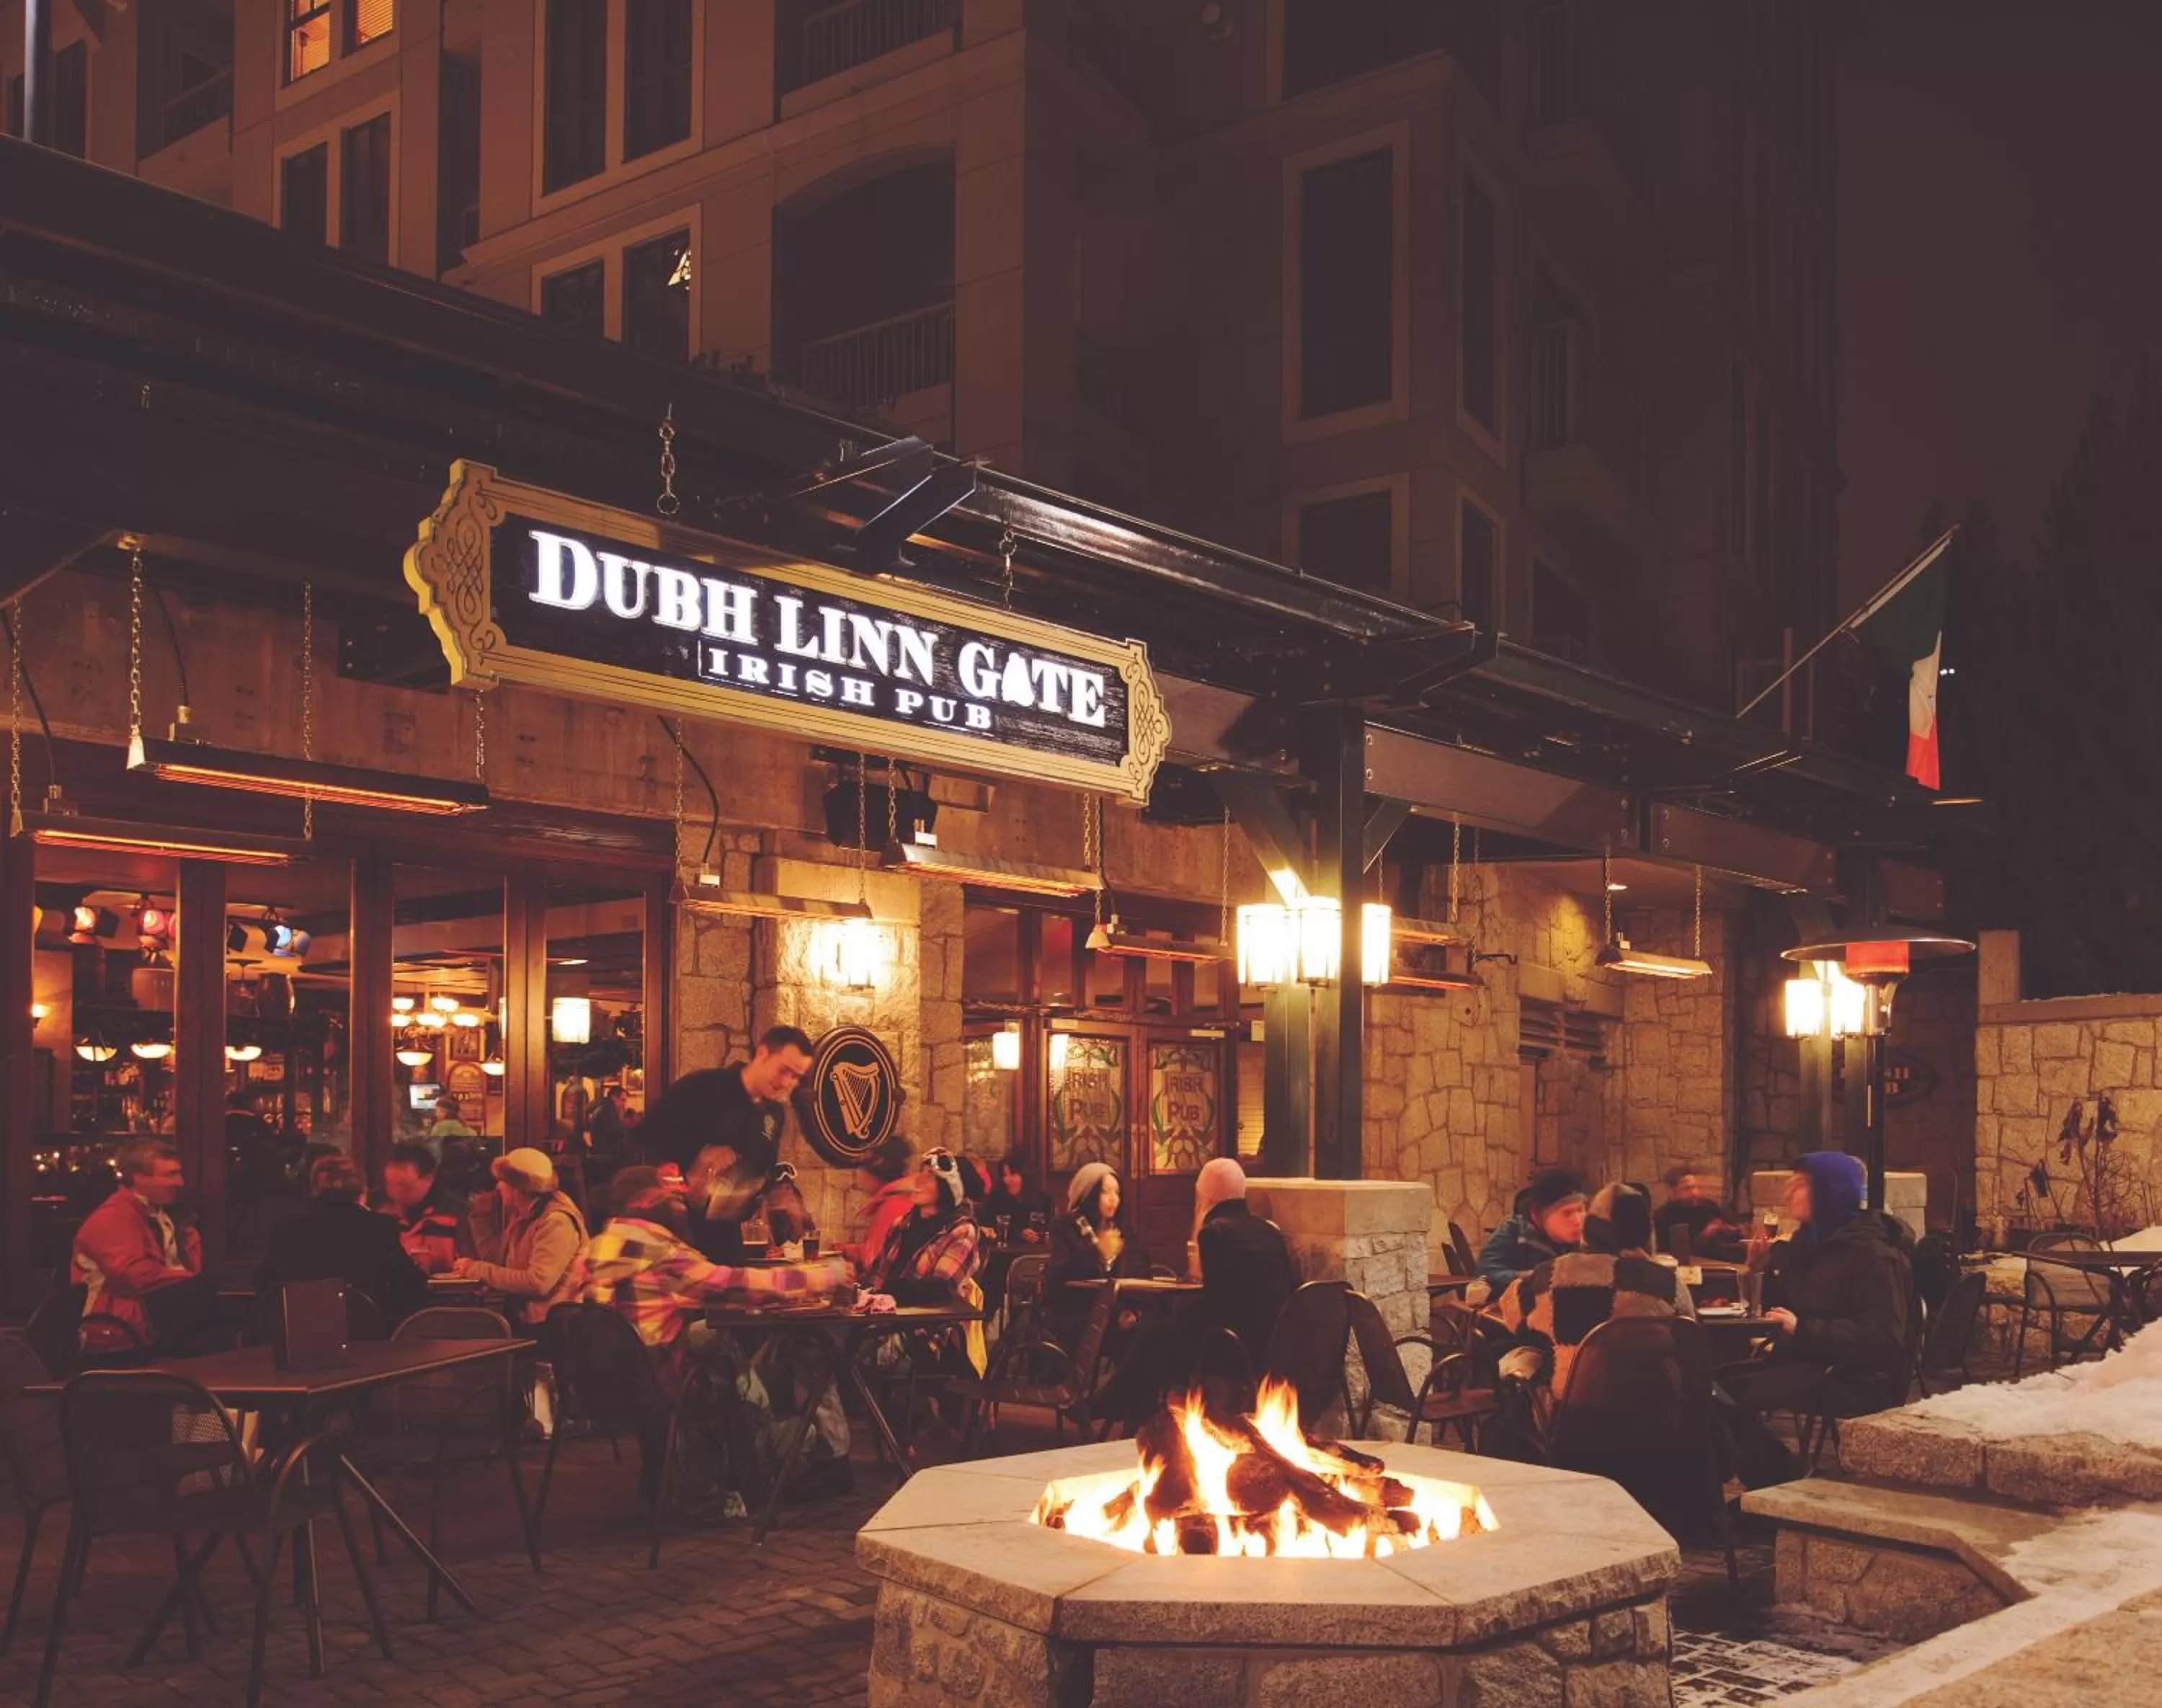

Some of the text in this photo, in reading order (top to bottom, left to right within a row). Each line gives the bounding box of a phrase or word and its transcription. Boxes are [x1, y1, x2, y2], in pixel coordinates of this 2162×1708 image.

[529, 530, 758, 646] DUBH
[774, 595, 938, 685] LINN
[708, 647, 992, 730] IRISH PUB
[1069, 1098, 1106, 1121] PUB
[1167, 1100, 1201, 1123] PUB
